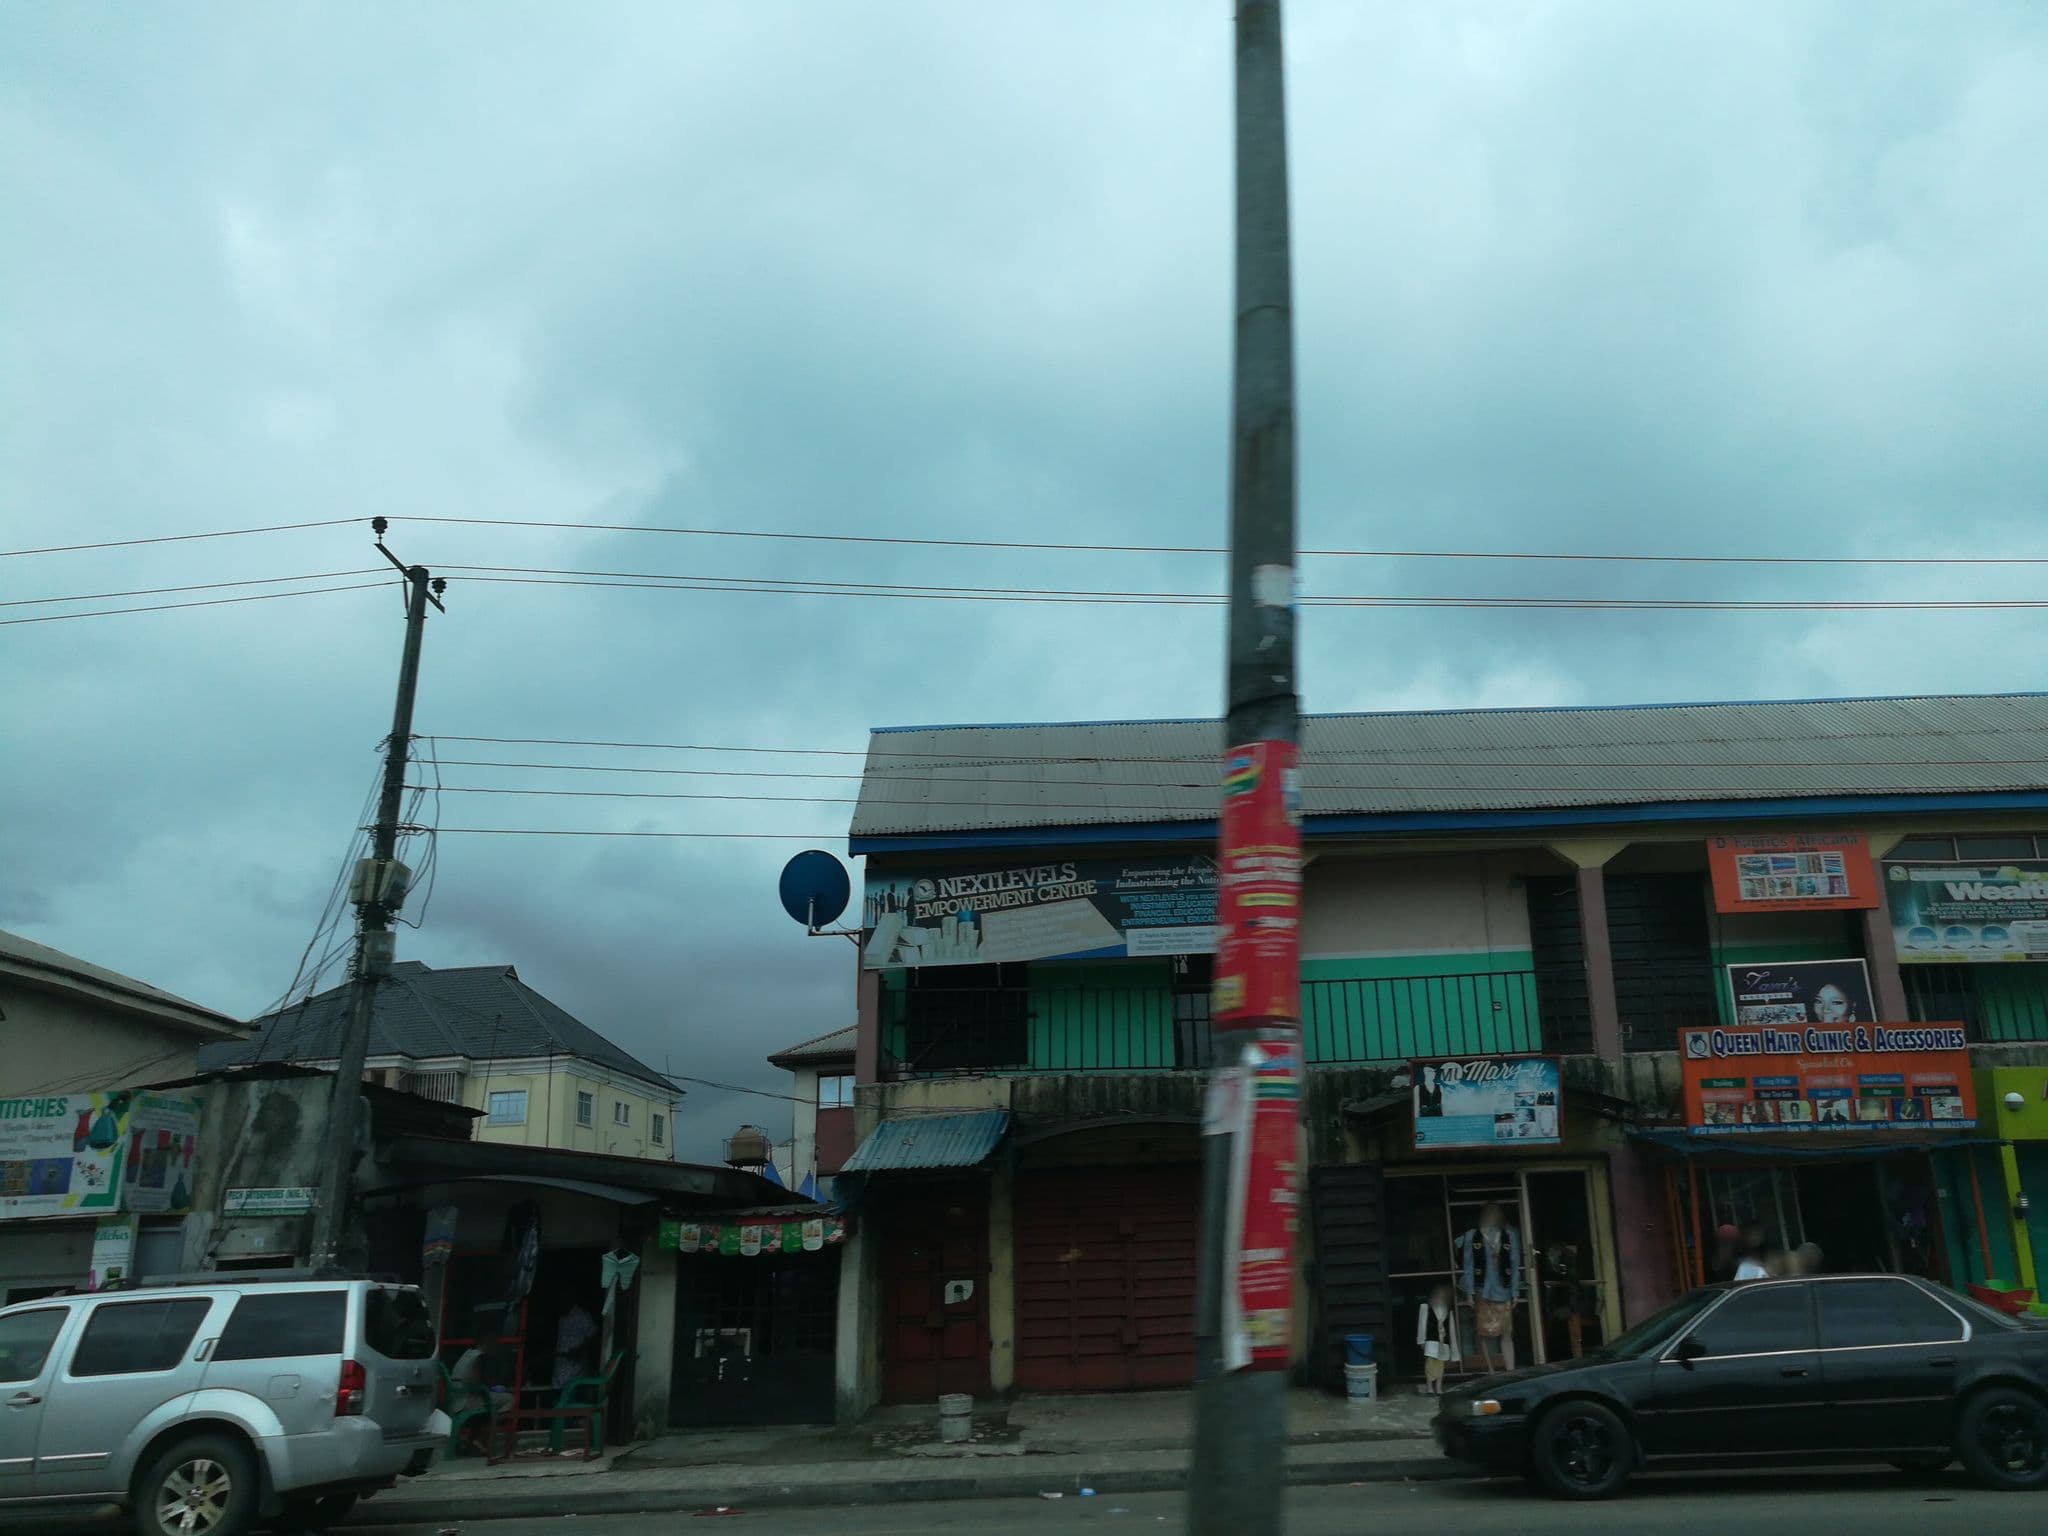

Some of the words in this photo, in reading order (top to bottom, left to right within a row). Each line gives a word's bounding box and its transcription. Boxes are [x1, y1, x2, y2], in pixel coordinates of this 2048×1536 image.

[938, 863, 1078, 898] NEXTLEVELS
[1172, 867, 1185, 875] the
[1180, 875, 1196, 886] the
[914, 888, 1034, 919] EMPOWERMENT
[1037, 879, 1098, 901] CENTRE
[1711, 1029, 1762, 1058] QUEEN
[1762, 1028, 1803, 1055] HAIR
[1804, 1027, 1851, 1053] CLINIC
[1854, 1027, 1870, 1052] &
[1874, 1026, 1966, 1052] ACCESSORIES
